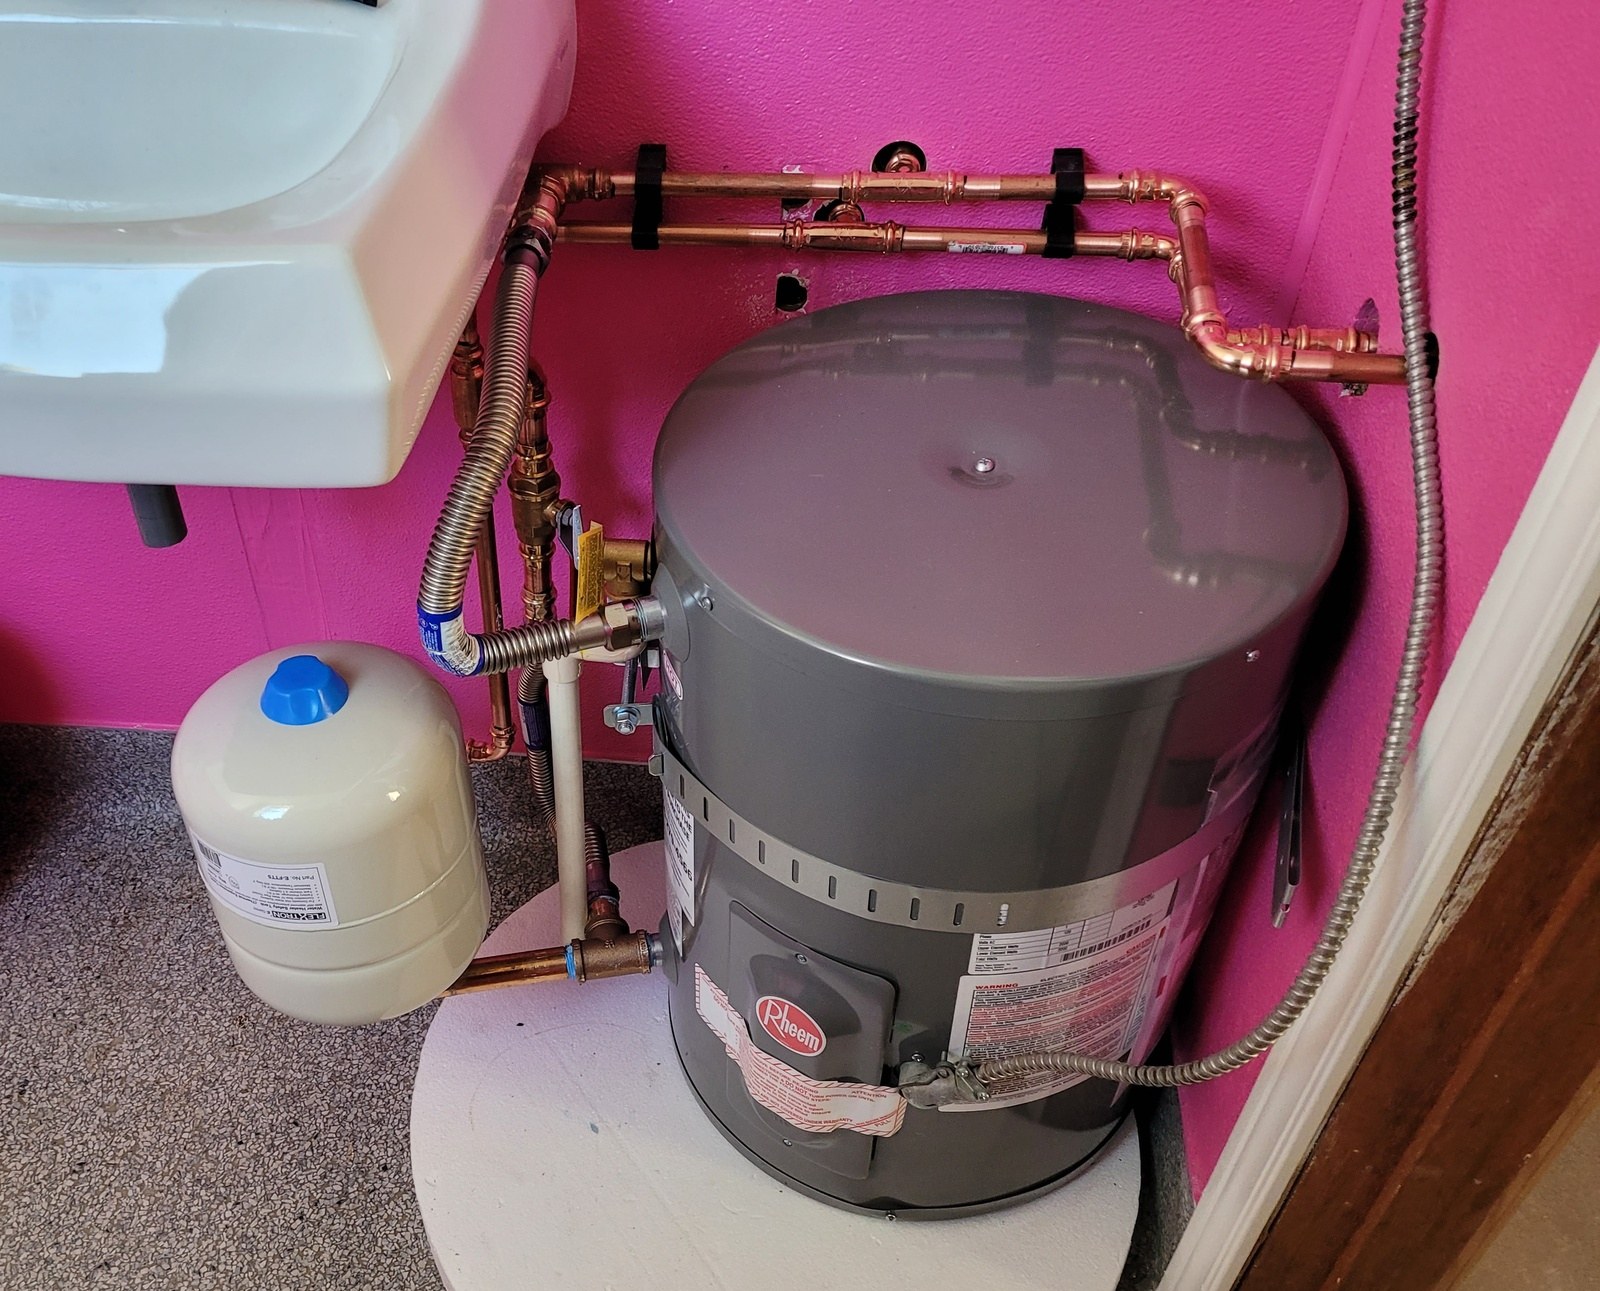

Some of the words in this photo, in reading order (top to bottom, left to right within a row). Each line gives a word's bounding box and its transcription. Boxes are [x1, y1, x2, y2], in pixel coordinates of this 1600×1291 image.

[272, 911, 326, 920] FLEXTRON
[1040, 974, 1067, 982] ELECTRIC
[1068, 967, 1088, 976] WATER
[1087, 959, 1108, 970] HEATER
[763, 999, 820, 1052] Rheem
[785, 1080, 794, 1089] DO
[794, 1085, 807, 1095] NOT
[793, 1080, 819, 1094] READING
[851, 1090, 887, 1099] ATTENTION
[779, 1105, 803, 1120] COVERED
[804, 1117, 823, 1125] UNDER
[874, 1119, 892, 1128] PULL
